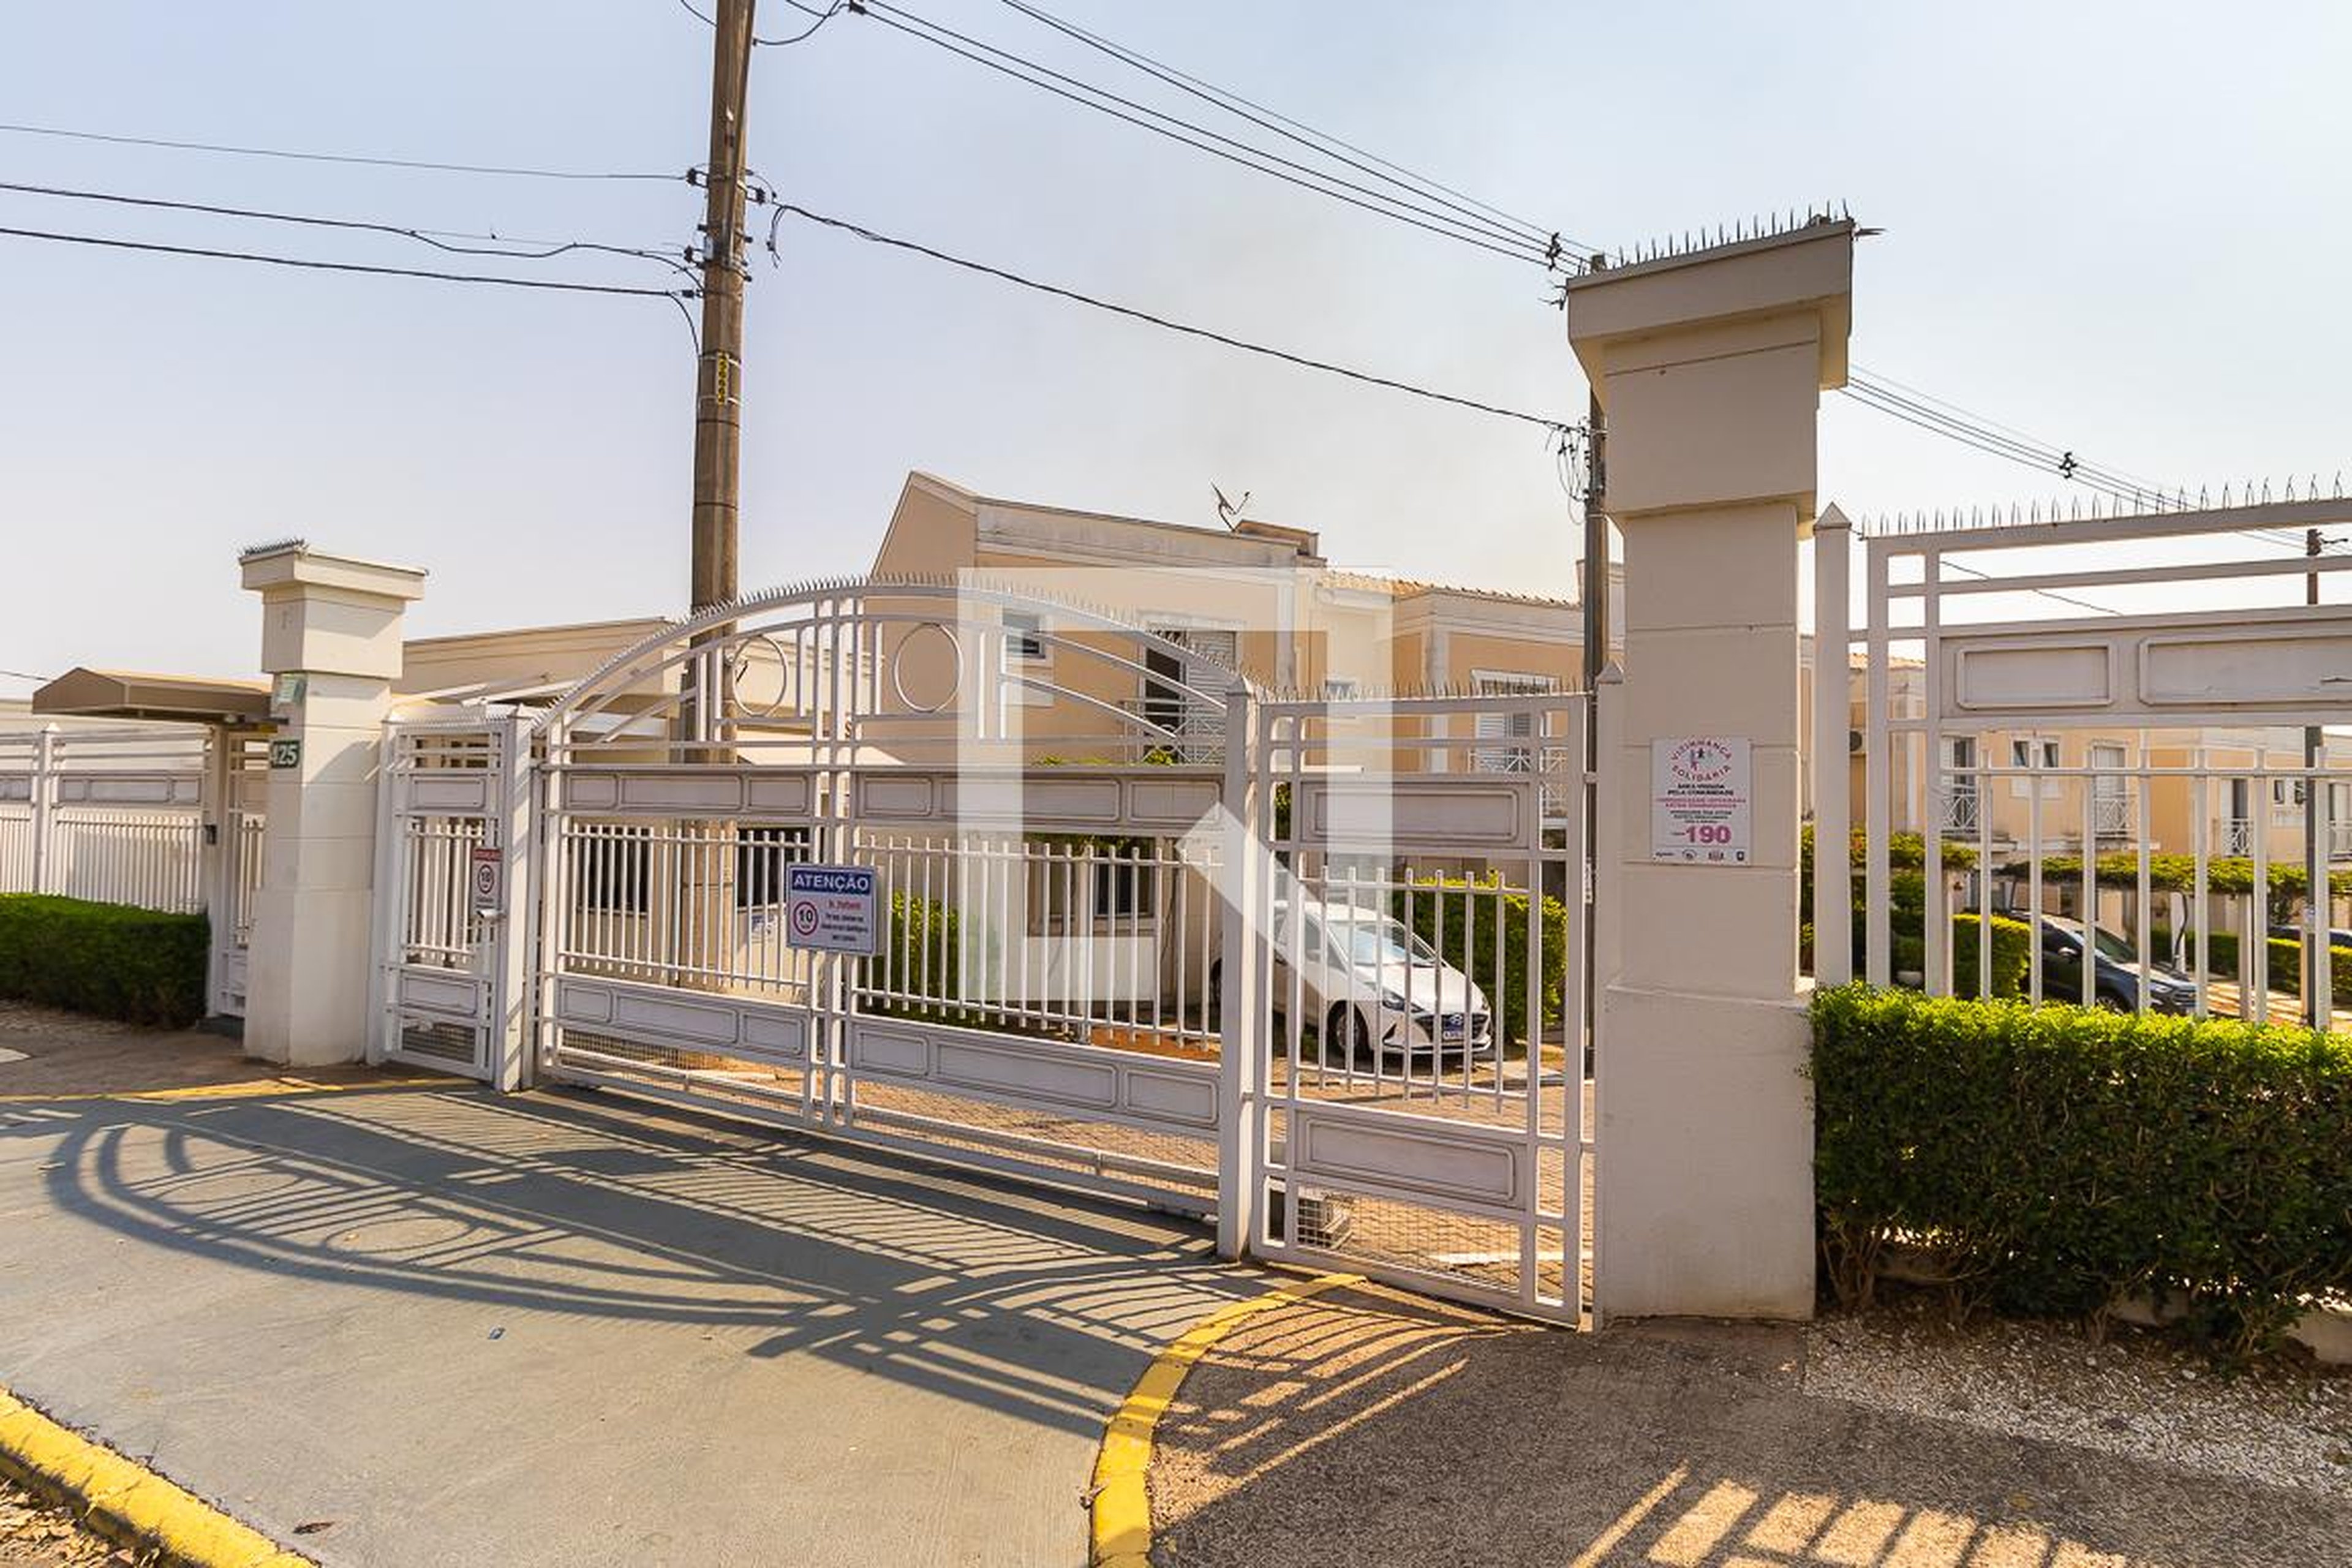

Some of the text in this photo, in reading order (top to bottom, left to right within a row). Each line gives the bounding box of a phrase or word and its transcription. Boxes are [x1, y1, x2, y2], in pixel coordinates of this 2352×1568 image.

[1686, 824, 1732, 843] 190
[793, 872, 869, 892] ATENÇÃO
[799, 910, 813, 923] 10
